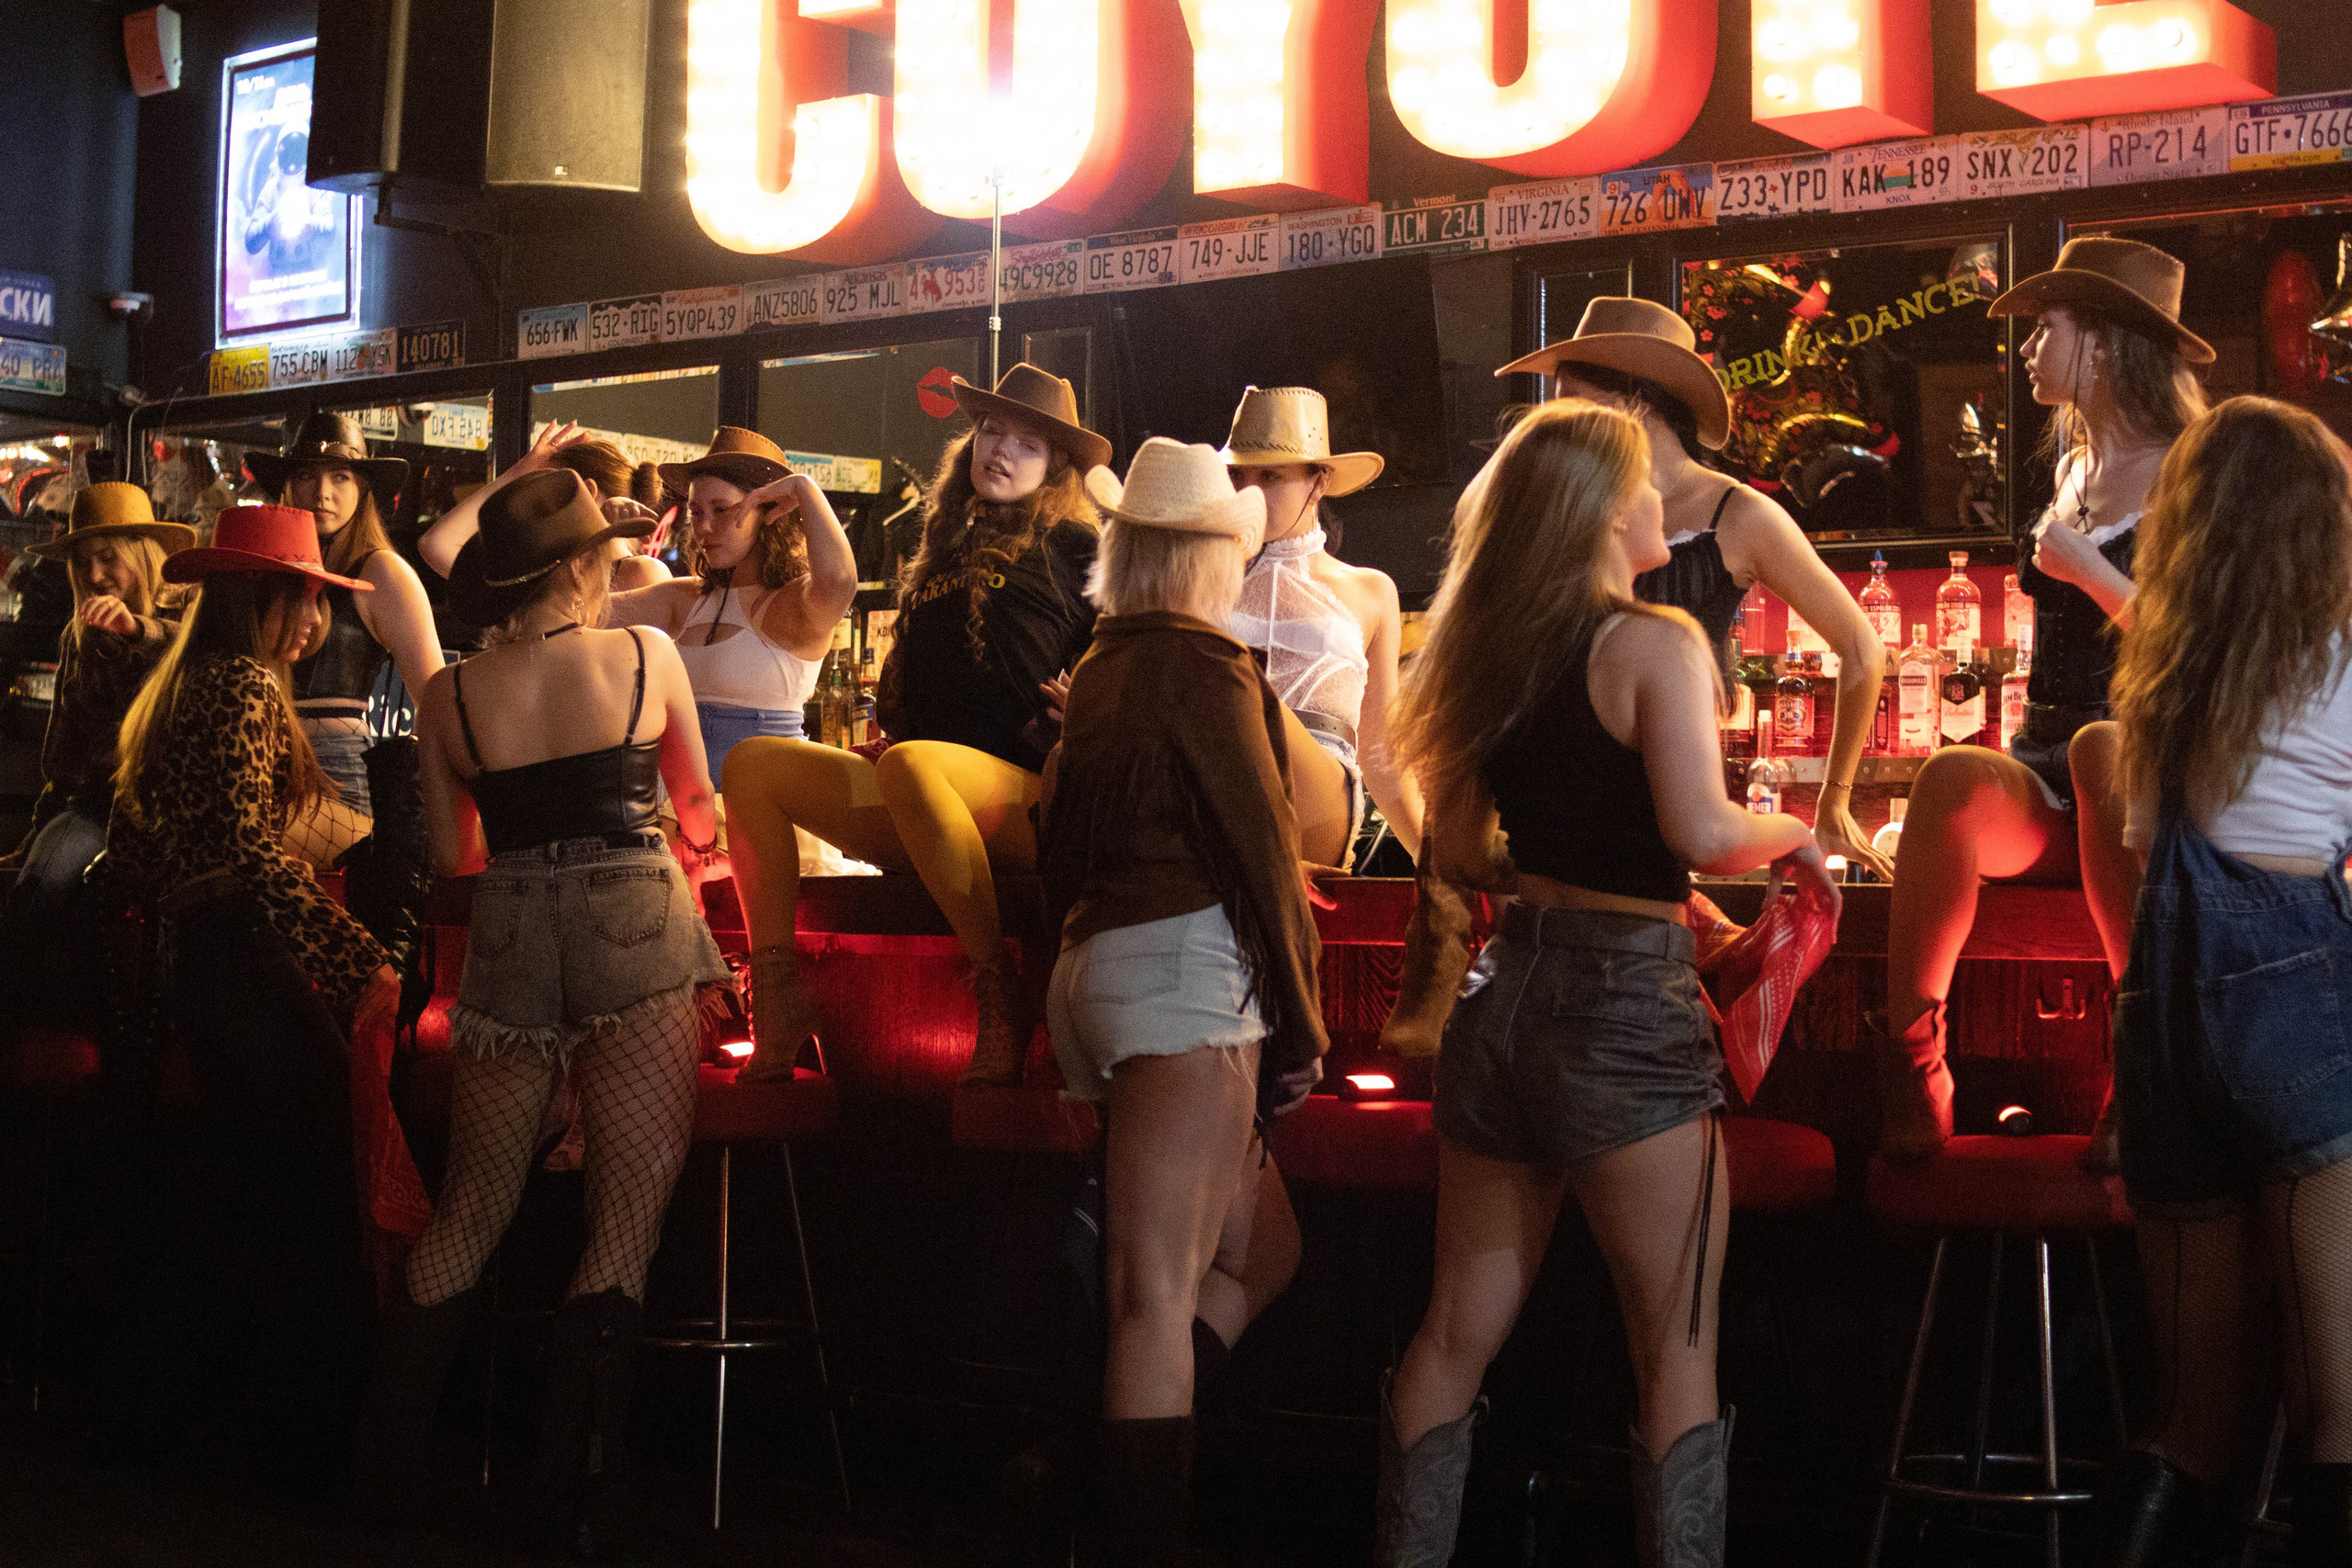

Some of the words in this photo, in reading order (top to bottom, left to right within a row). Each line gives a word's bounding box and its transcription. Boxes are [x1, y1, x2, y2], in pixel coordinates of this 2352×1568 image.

[2261, 99, 2331, 115] PENNSYLVANIA
[1871, 142, 1925, 163] TENNESSEE
[2109, 125, 2206, 168] RP-214
[1842, 164, 1886, 197] KAK
[1906, 155, 1951, 189] 189
[1967, 148, 2012, 181] SNX
[2032, 143, 2077, 175] 202
[2163, 166, 2191, 179] State
[1517, 185, 1569, 200] VIRGINIA
[1644, 174, 1670, 186] UTAH
[1413, 193, 1456, 208] Vermont
[1606, 191, 1648, 226] 726
[1886, 193, 1912, 204] KNOX
[1286, 217, 1342, 231] WASHINGTON
[1390, 211, 1428, 245] ACM
[1441, 204, 1478, 240] 234
[1121, 246, 1172, 276] 8787
[1190, 231, 1269, 270] 749-JJE
[827, 286, 858, 313] 925
[869, 281, 901, 310] MJL
[944, 267, 975, 298] 953
[753, 288, 818, 321] ANZ5806
[401, 330, 458, 365] 140781
[272, 354, 298, 378] 755
[301, 348, 328, 374] CBM
